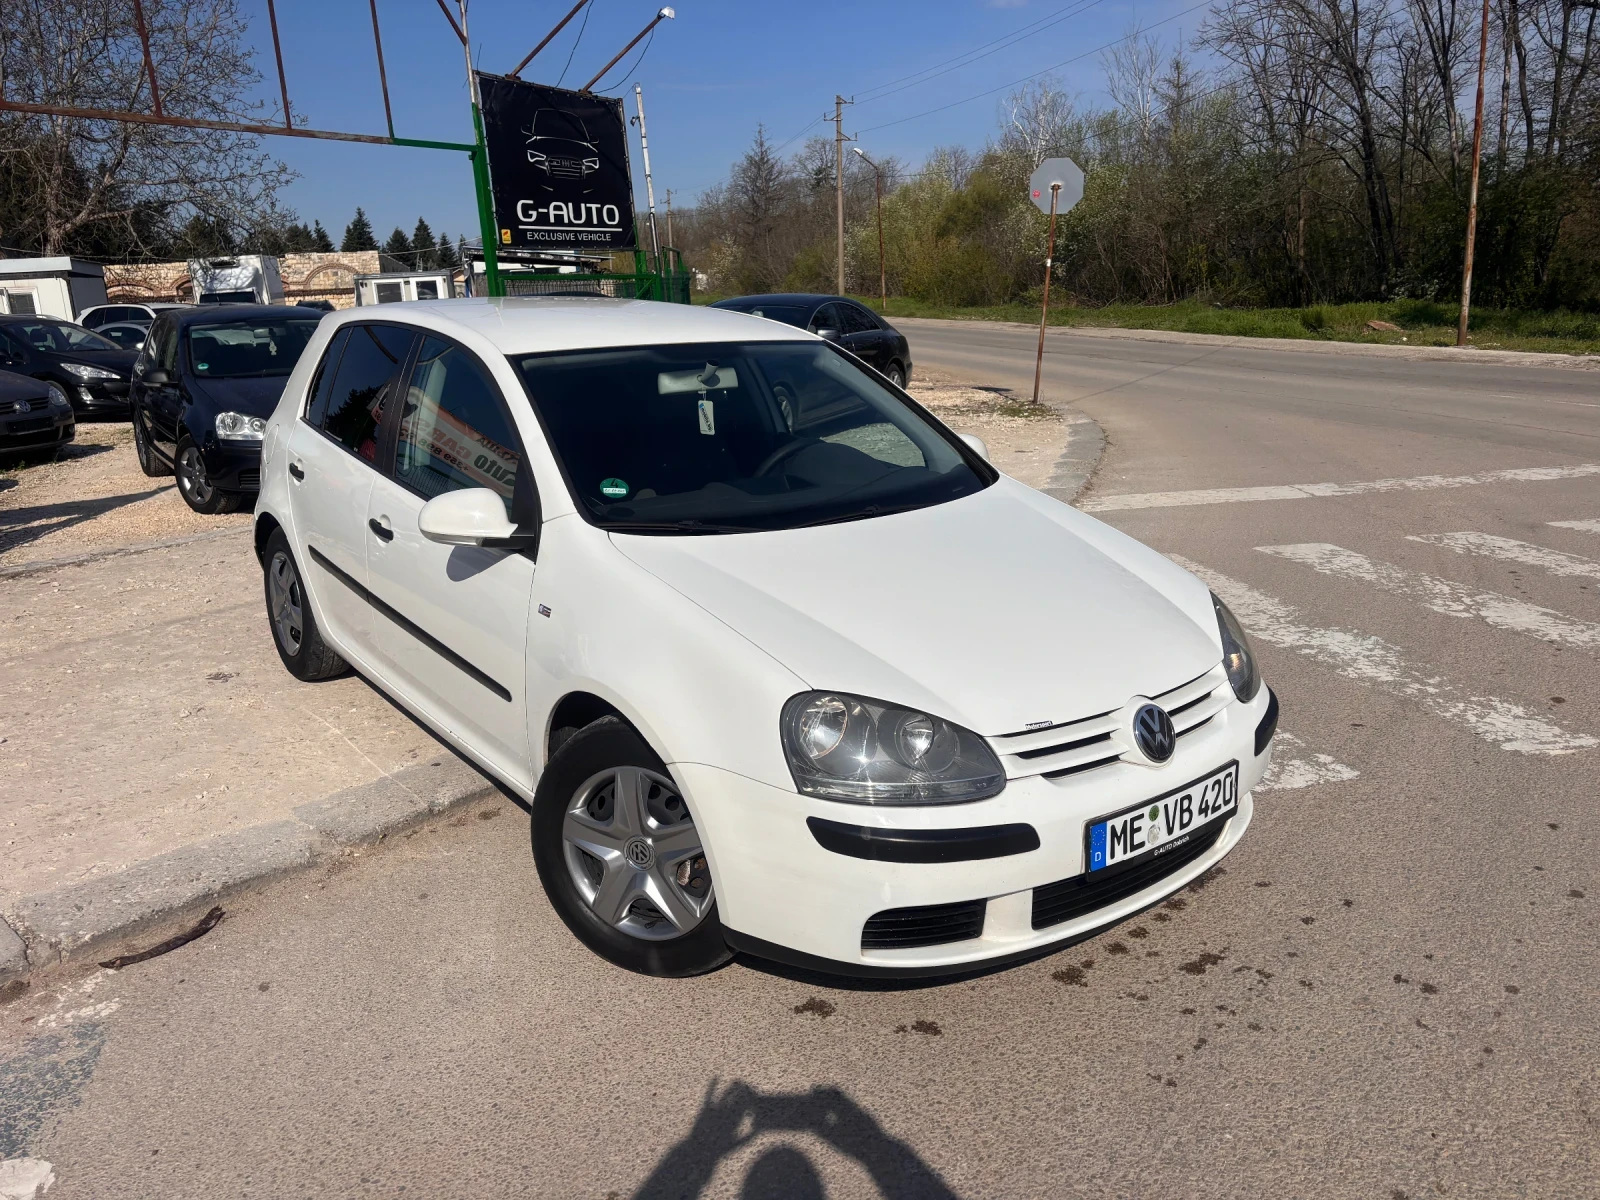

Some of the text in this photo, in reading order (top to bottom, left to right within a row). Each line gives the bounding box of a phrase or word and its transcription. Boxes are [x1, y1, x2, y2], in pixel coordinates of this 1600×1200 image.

[516, 199, 620, 225] G-AUTO
[526, 231, 612, 242] EXCLUSIVE VEHICLE
[1109, 771, 1234, 860] ME VB 420
[1153, 843, 1173, 856] G-AUTO
[1094, 851, 1102, 862] D
